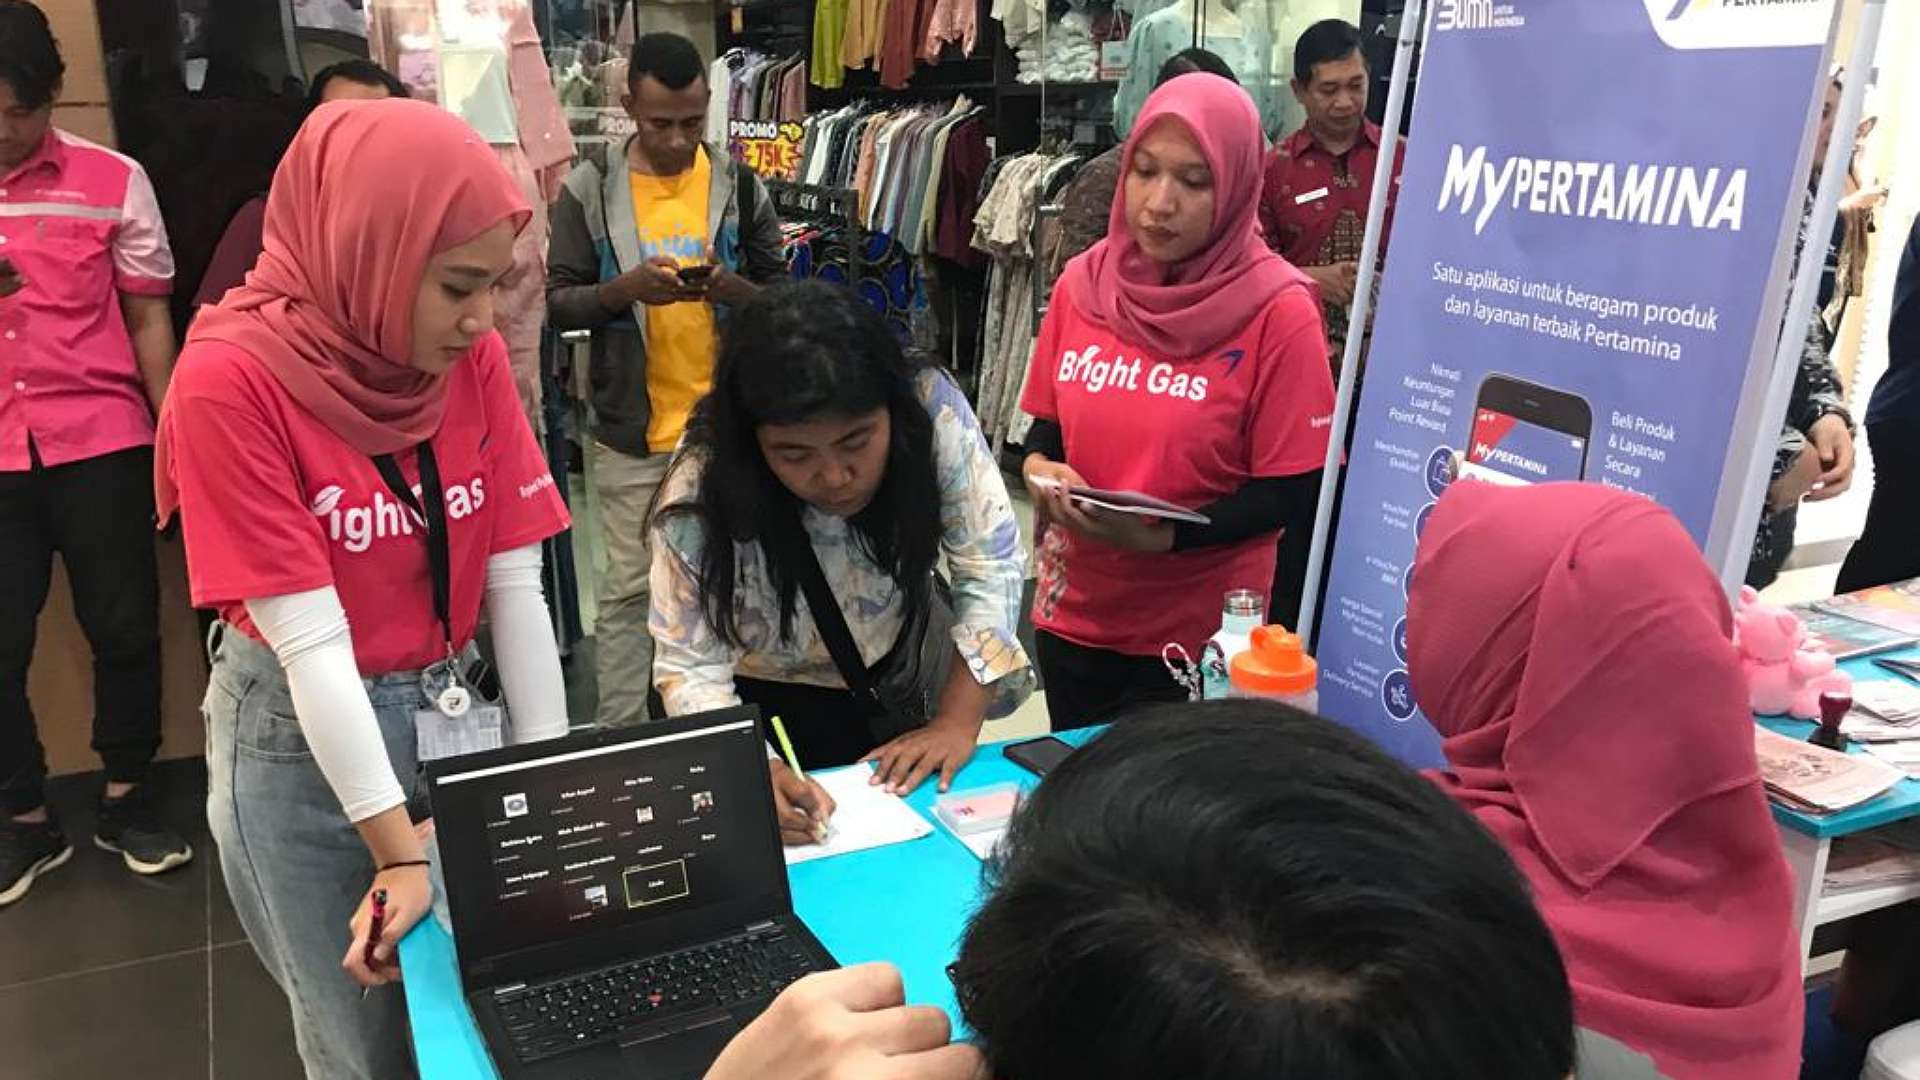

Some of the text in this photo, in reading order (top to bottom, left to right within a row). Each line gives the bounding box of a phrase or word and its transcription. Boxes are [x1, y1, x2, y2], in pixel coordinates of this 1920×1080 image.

[730, 121, 777, 139] PROMO
[1437, 143, 1747, 235] MyPERTAMINA
[1432, 262, 1719, 331] Satu aplikasi untuk beragam produk
[1444, 294, 1681, 361] dan layanan terbaik Pertamina
[1058, 345, 1209, 401] Bright Gas
[1388, 406, 1415, 425] Point
[1611, 410, 1675, 442] Beli Produk
[1608, 432, 1667, 463] & Layanan
[1604, 454, 1641, 479] Secara
